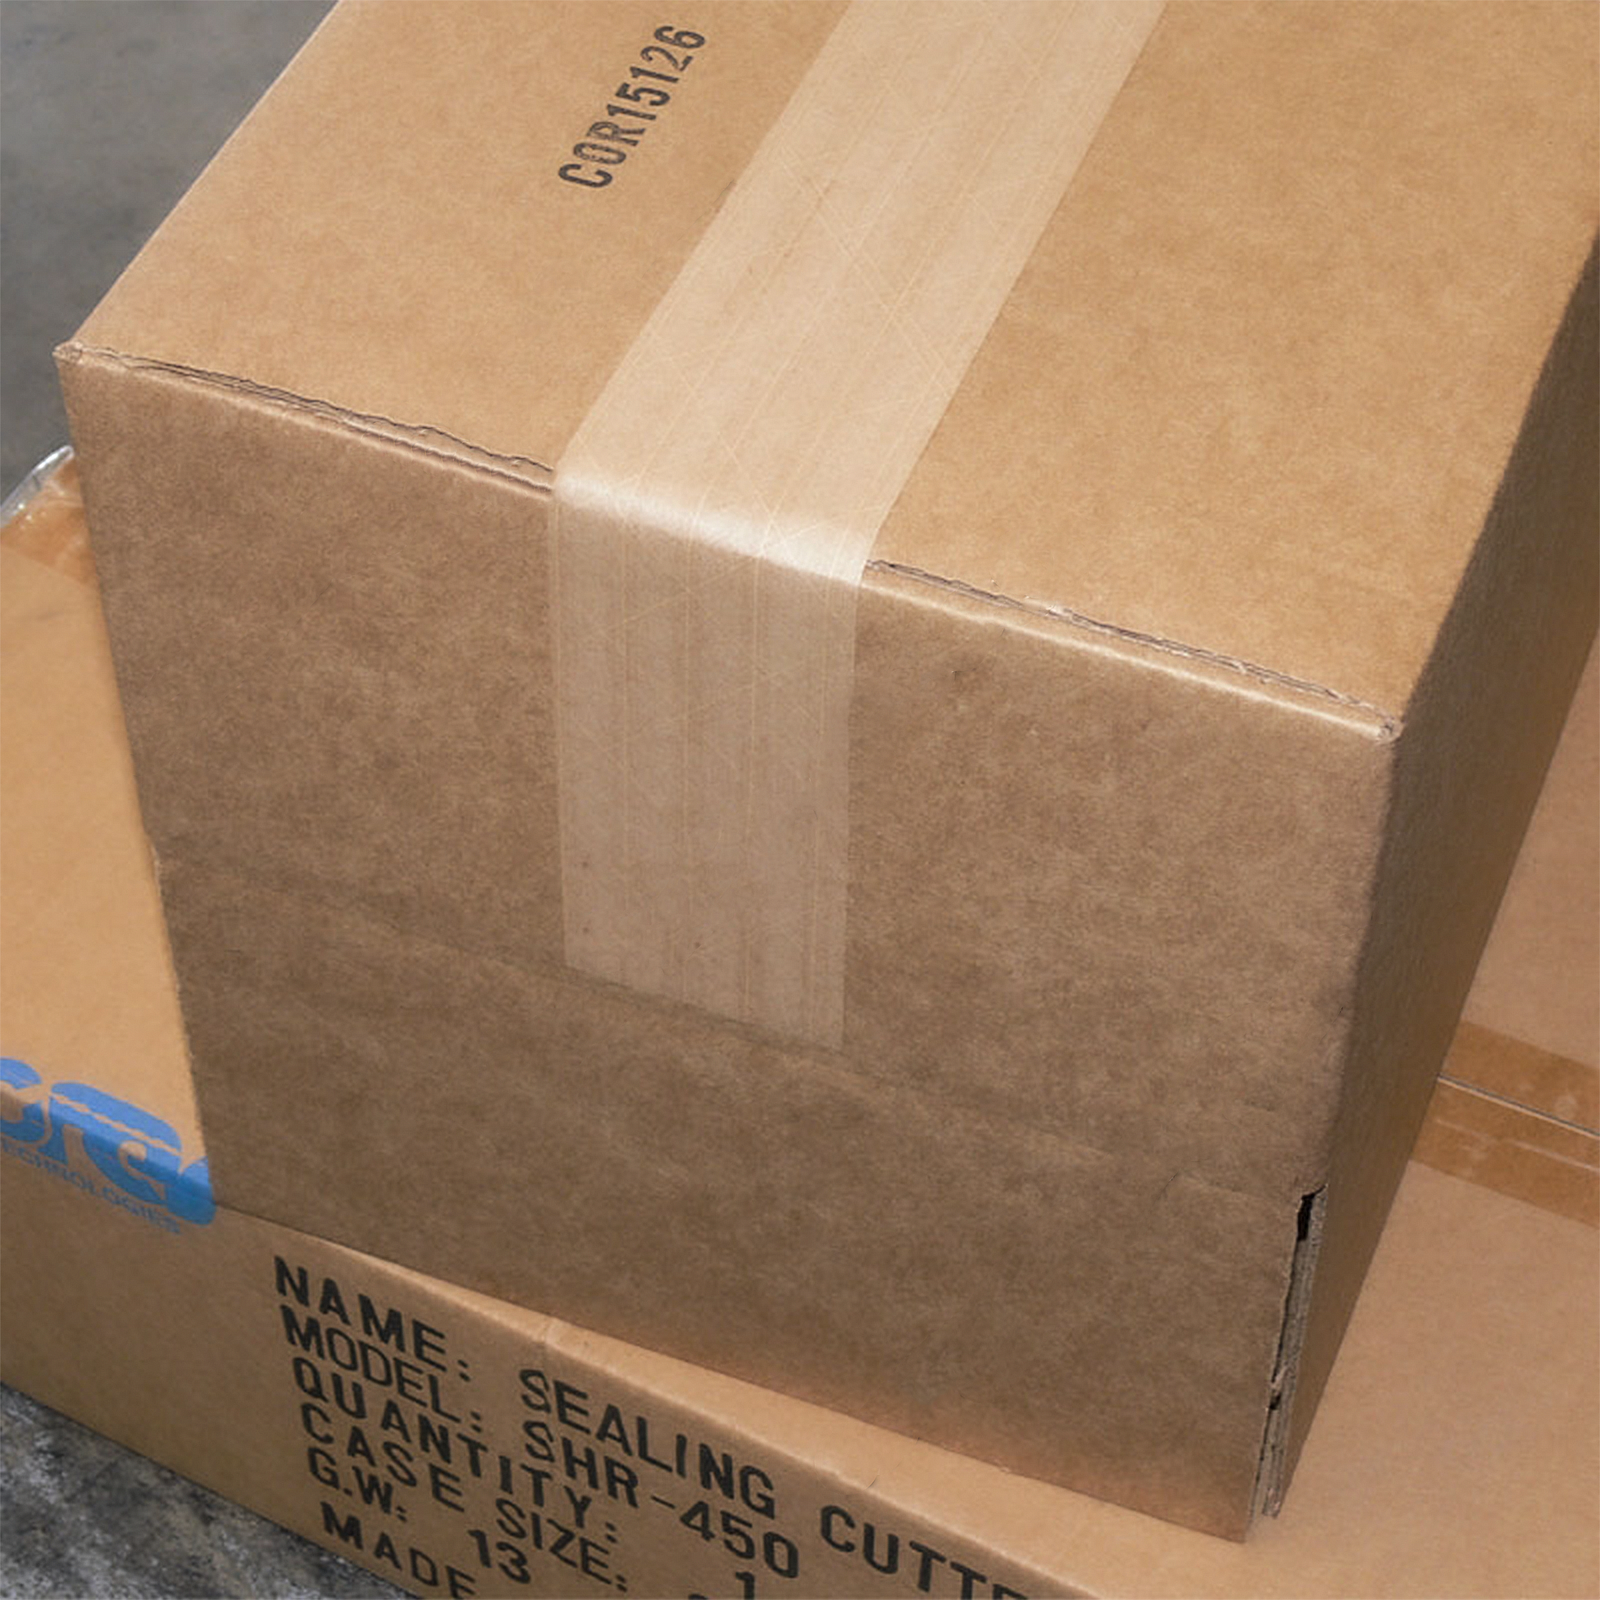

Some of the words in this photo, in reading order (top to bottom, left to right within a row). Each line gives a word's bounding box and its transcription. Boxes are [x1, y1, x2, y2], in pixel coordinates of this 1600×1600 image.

[558, 25, 706, 188] COR15126
[274, 1256, 471, 1382] NAME:
[519, 1369, 775, 1520] SEALING
[281, 1305, 482, 1432] MODEL:
[522, 1421, 799, 1578] SHR-450
[293, 1357, 618, 1544] QUANTITY:
[301, 1403, 465, 1513] CASE
[496, 1499, 628, 1593] SIZE:
[320, 1502, 476, 1600] MADE
[468, 1529, 531, 1584] 13
